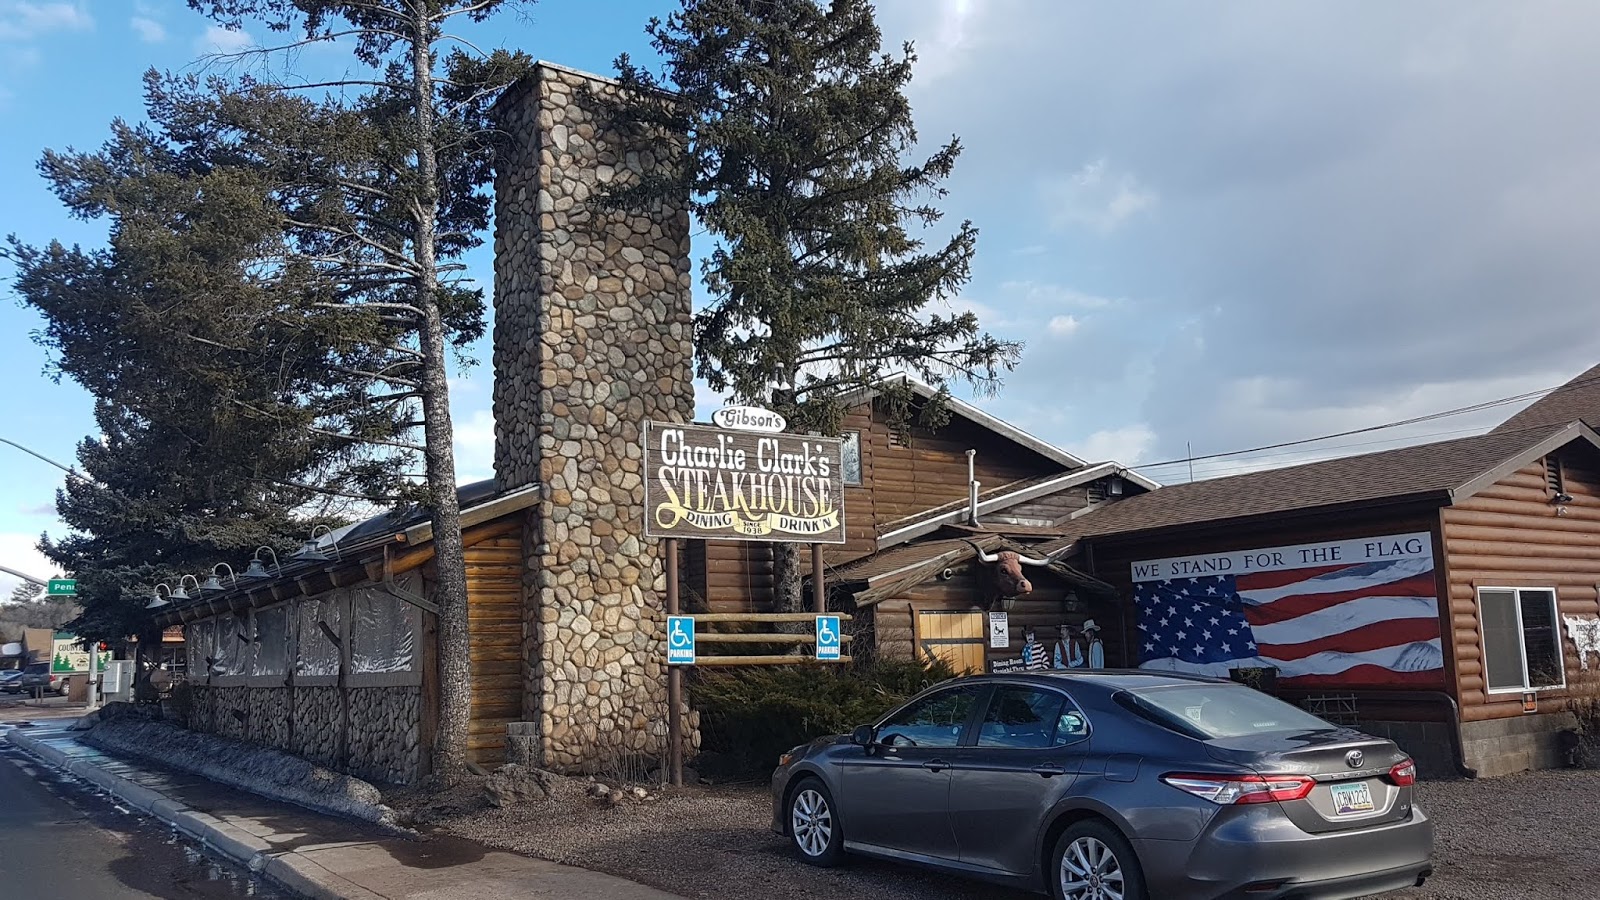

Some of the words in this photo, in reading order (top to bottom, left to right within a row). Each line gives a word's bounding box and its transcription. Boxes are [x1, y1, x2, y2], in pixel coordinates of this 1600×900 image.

[720, 409, 782, 428] Gibson's
[660, 429, 746, 470] Charlie
[757, 437, 830, 477] Clark's
[656, 466, 835, 528] STEAKHOUSE
[686, 511, 733, 526] DINING
[779, 517, 832, 532] DRINK'N
[743, 526, 763, 534] 1938
[1134, 563, 1160, 578] WE
[1171, 557, 1232, 575] STAND
[1244, 552, 1286, 569] FOR
[1298, 546, 1342, 564] THE
[1364, 538, 1423, 558] FLAG
[670, 648, 693, 658] PARKING
[818, 646, 839, 654] PARKING
